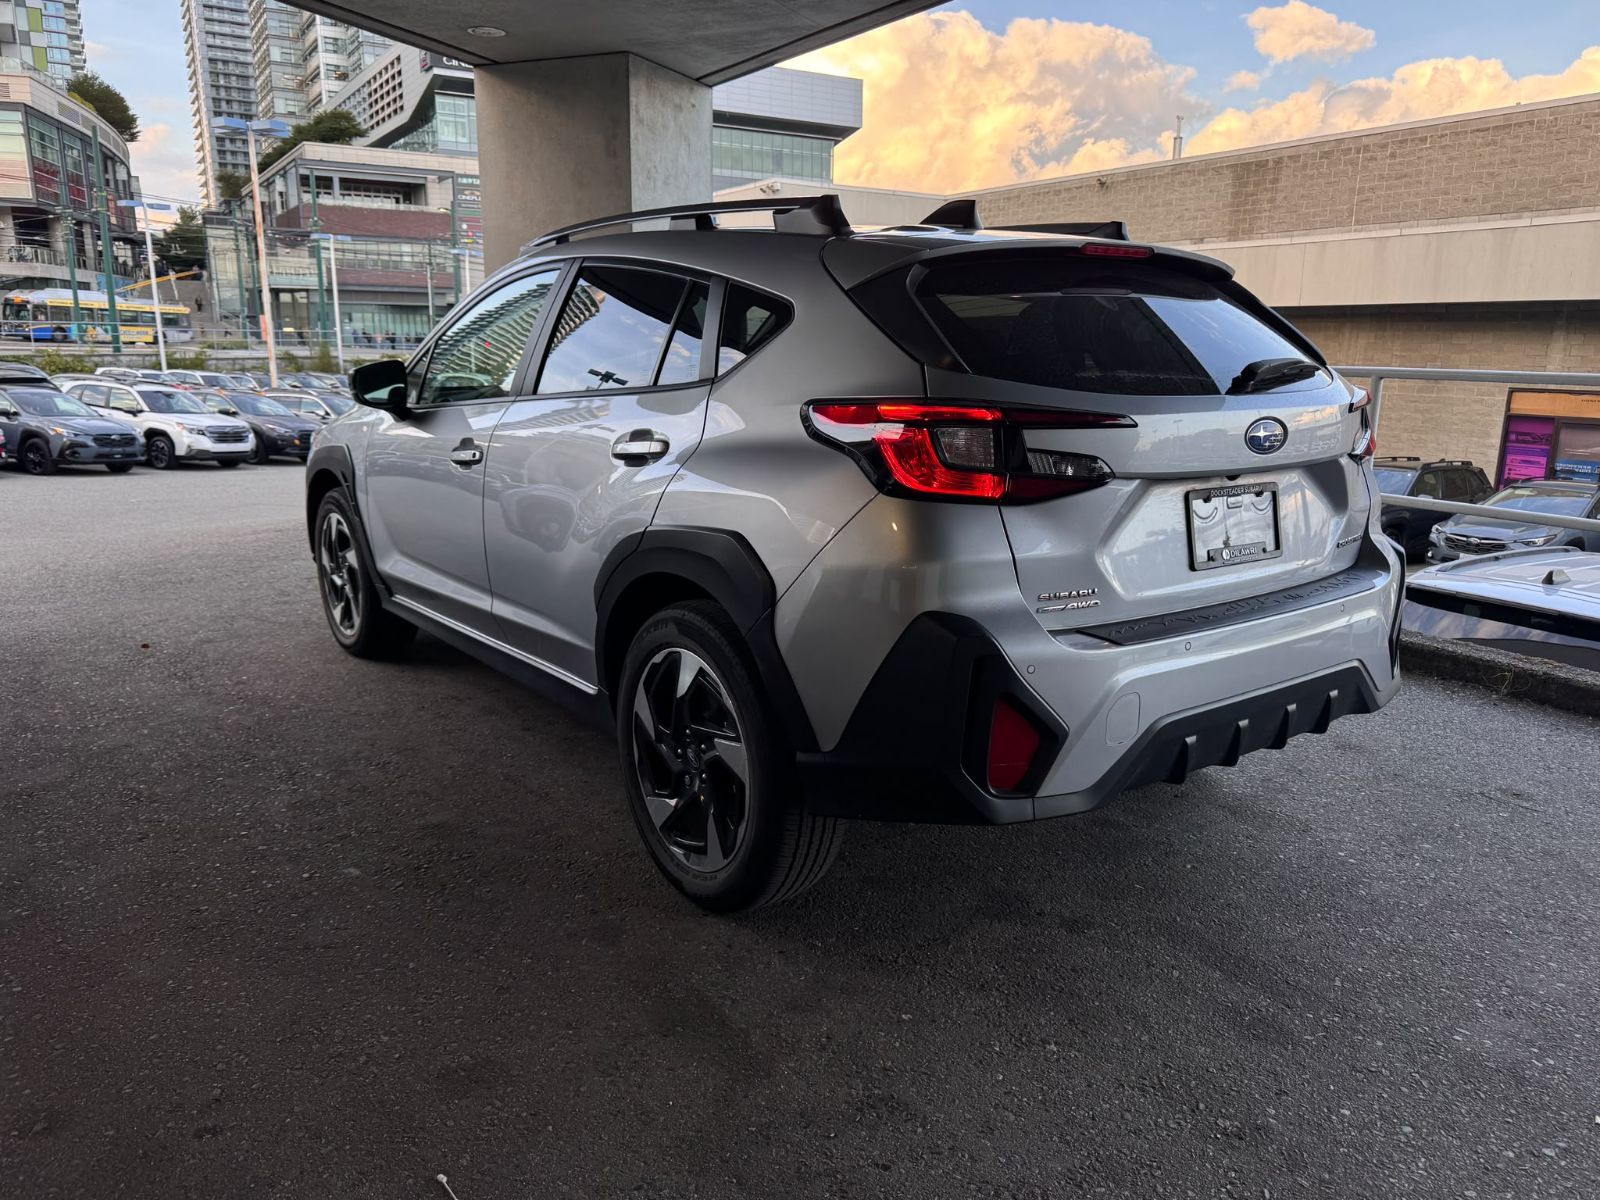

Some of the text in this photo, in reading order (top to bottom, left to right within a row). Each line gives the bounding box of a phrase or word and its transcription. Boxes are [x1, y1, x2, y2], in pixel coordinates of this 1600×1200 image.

[1210, 485, 1263, 497] DOCKSTEADER SUBARU
[1230, 547, 1257, 557] DILAWRI
[1037, 588, 1098, 601] SUBARU
